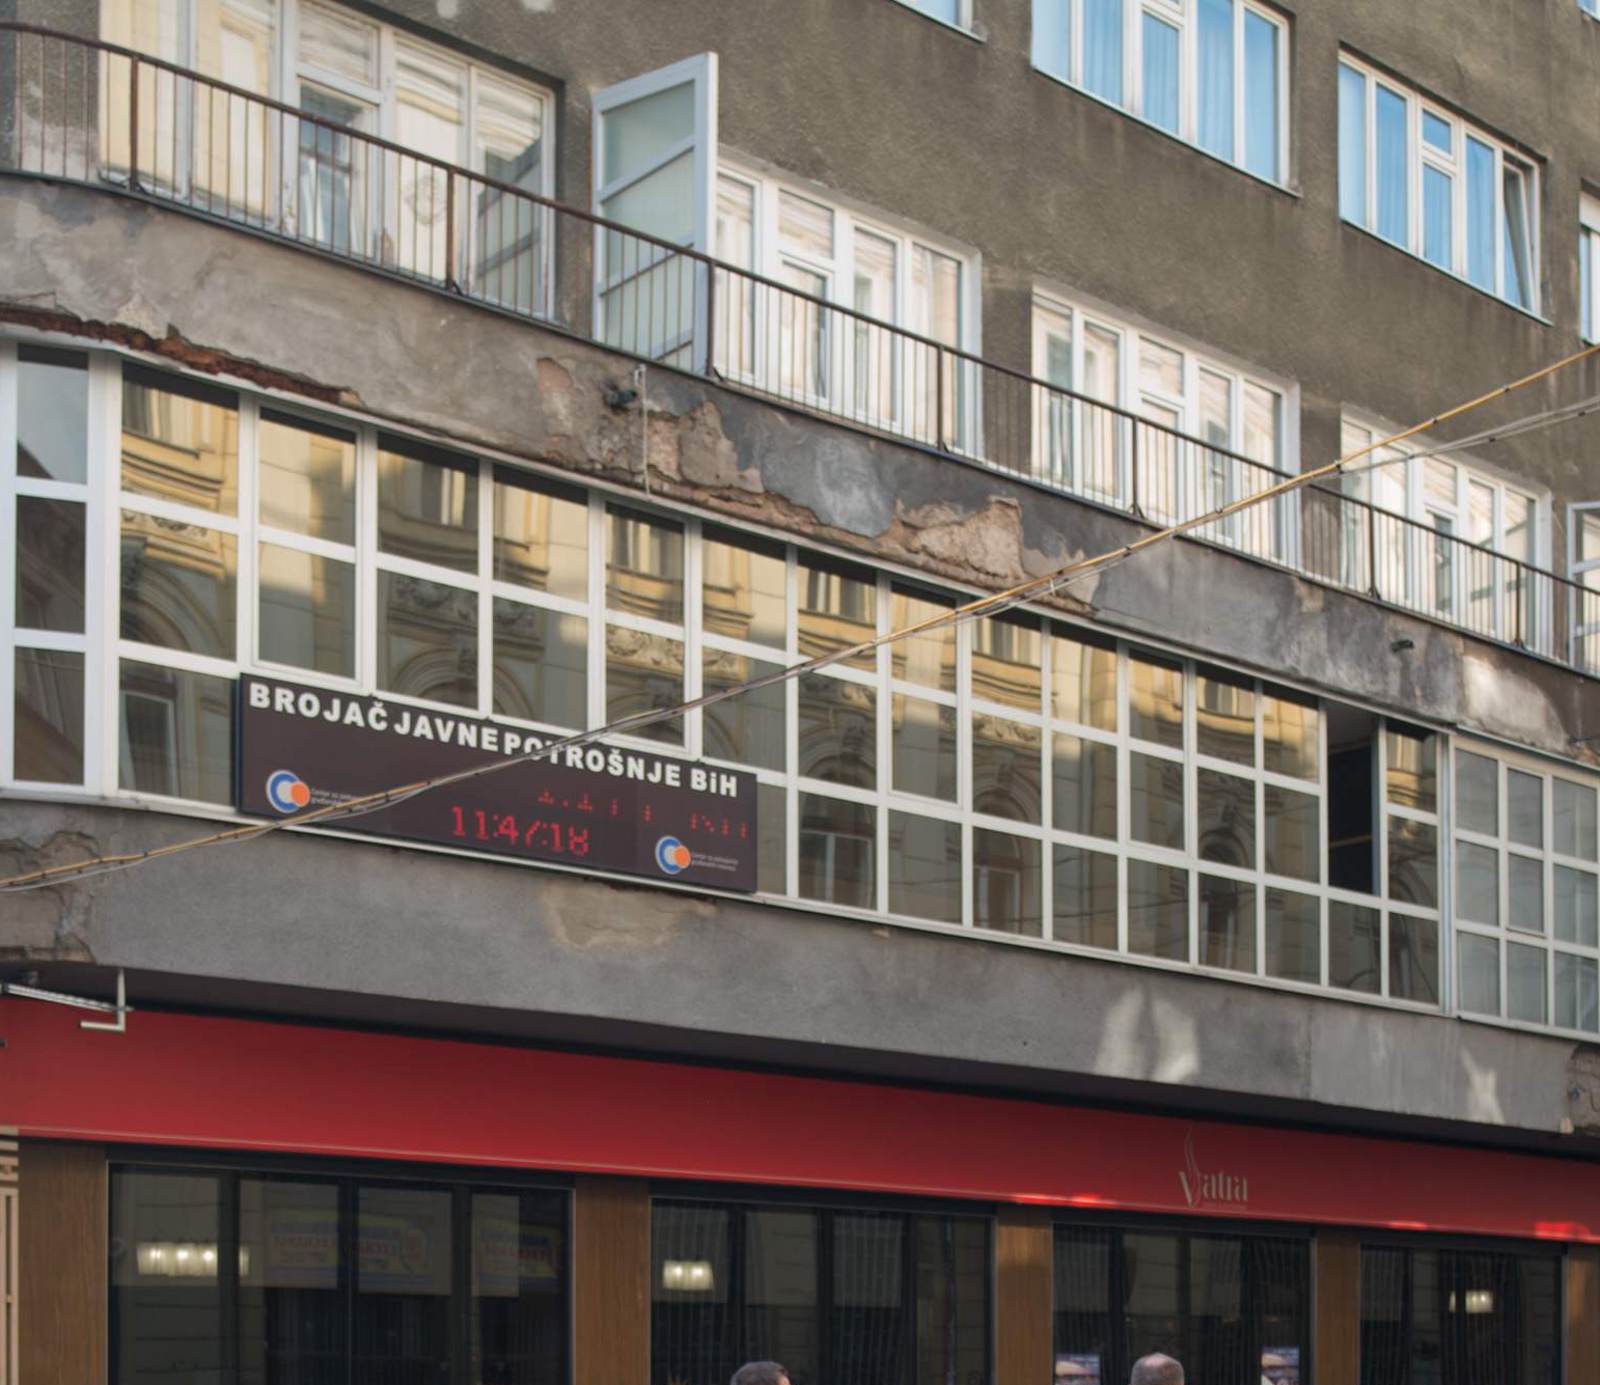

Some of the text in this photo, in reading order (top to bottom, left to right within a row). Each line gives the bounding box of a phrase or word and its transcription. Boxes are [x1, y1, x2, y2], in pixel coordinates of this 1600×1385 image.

[249, 681, 389, 732] BROJAČ
[393, 711, 499, 753] JAVNE
[690, 767, 738, 798] BiH
